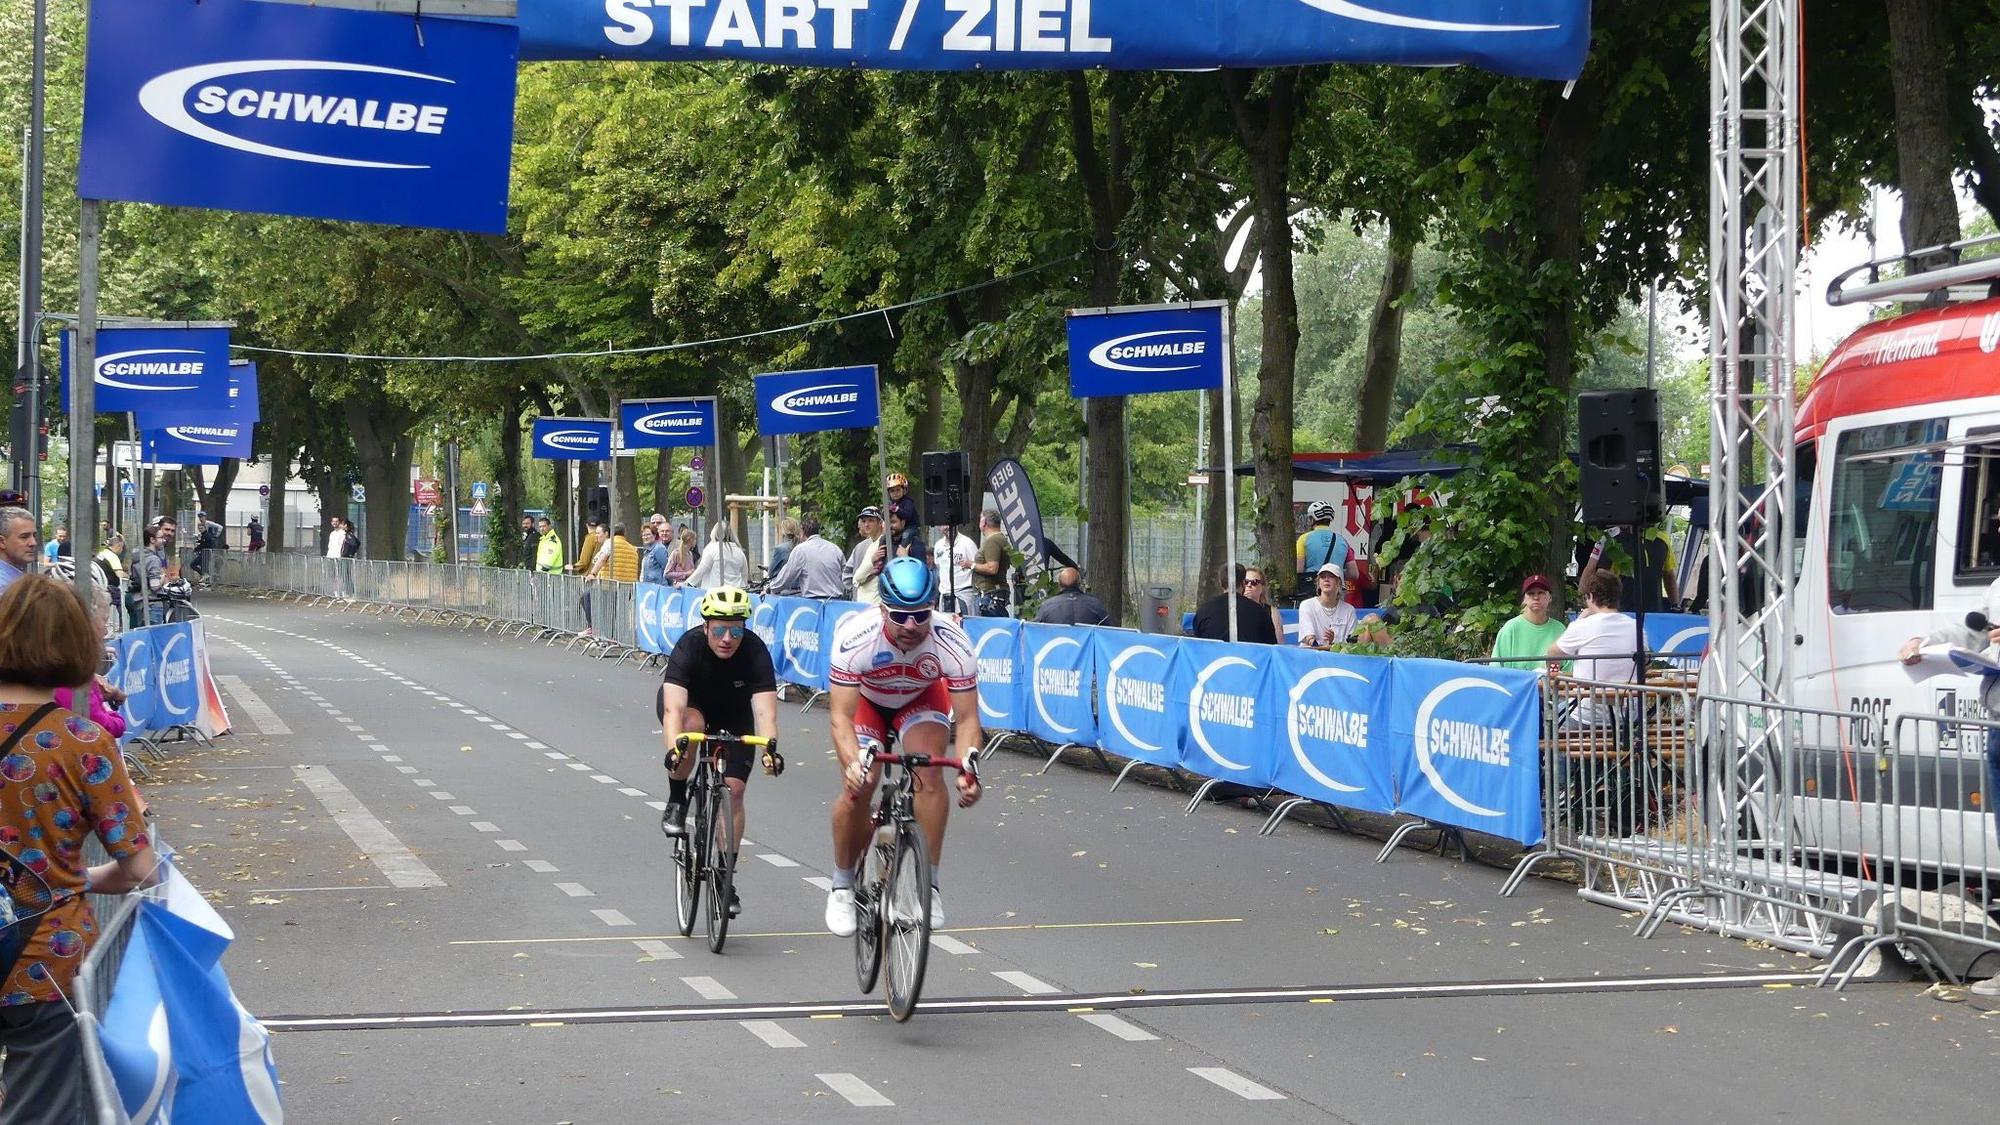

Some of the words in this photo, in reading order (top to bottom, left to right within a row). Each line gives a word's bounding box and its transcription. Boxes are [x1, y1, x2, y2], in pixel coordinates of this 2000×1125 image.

[603, 0, 867, 48] START
[942, 0, 1113, 52] ZIEL
[194, 86, 449, 134] SCHWALBE
[1109, 342, 1205, 359] SCHWALBE
[103, 362, 204, 376] SCHWALBE
[786, 392, 858, 407] SCHWALBE
[178, 426, 238, 437] SCHWALBE
[646, 417, 703, 428] SCHWALBE
[552, 435, 599, 444] SCHWALBE
[977, 657, 1013, 684] SCHWALBE
[1039, 667, 1081, 698] SCHWALBE
[1116, 676, 1165, 714] SCHWALBE
[1199, 691, 1255, 729] SCHWALBE
[1297, 703, 1369, 749] SCHWALBE
[1429, 716, 1510, 767] SCHWALBE
